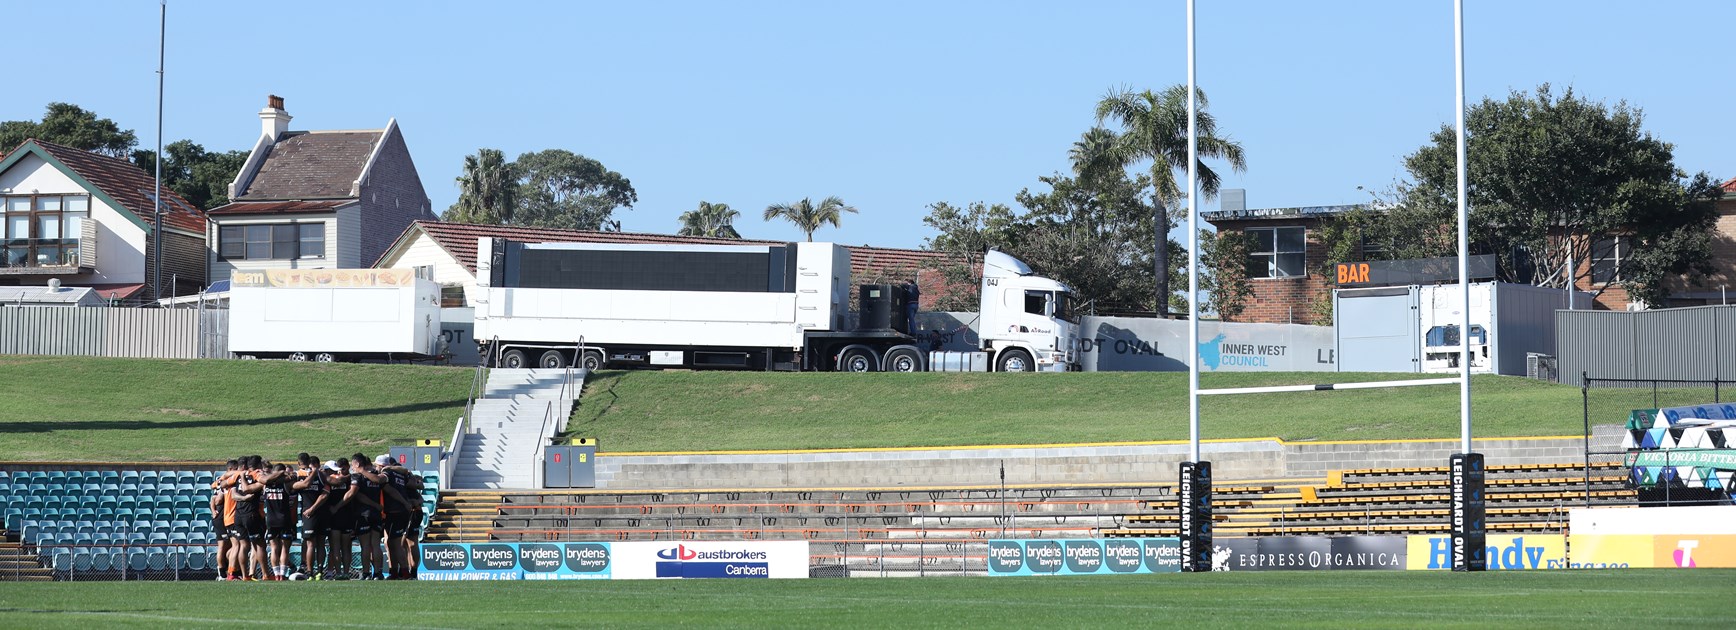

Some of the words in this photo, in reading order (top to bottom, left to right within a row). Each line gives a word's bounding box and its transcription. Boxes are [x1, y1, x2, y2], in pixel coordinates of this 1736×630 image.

[1337, 263, 1370, 284] BAR
[1114, 340, 1164, 356] OVAL
[1222, 343, 1255, 355] INNER
[1257, 345, 1287, 356] WEST
[1221, 355, 1269, 367] COUNCIL
[1182, 466, 1191, 537] LEICHHARDT
[1453, 458, 1464, 534] LEICHHARDT
[424, 549, 465, 561] brydens
[473, 549, 512, 561] brydens
[521, 548, 559, 560] brydens
[567, 547, 606, 560] brydens
[698, 549, 767, 560] austbrokers
[990, 545, 1020, 560] brydens
[1027, 545, 1062, 560] brydens
[1066, 545, 1100, 559] brydens
[1106, 545, 1139, 559] brydens
[1182, 540, 1191, 569] OVAL
[1427, 536, 1544, 570] Hndy
[1454, 537, 1464, 568] OVAL
[439, 559, 465, 568] lawyers
[487, 559, 513, 568] lawyers
[535, 559, 560, 568] lawyers
[581, 558, 606, 568] lawyers
[1000, 557, 1021, 566] lawyers
[1039, 557, 1062, 566] lawyers
[1077, 557, 1100, 566] lawyers
[1118, 557, 1139, 566] lawyers
[500, 572, 517, 580] GAS
[725, 564, 768, 576] Canberra
